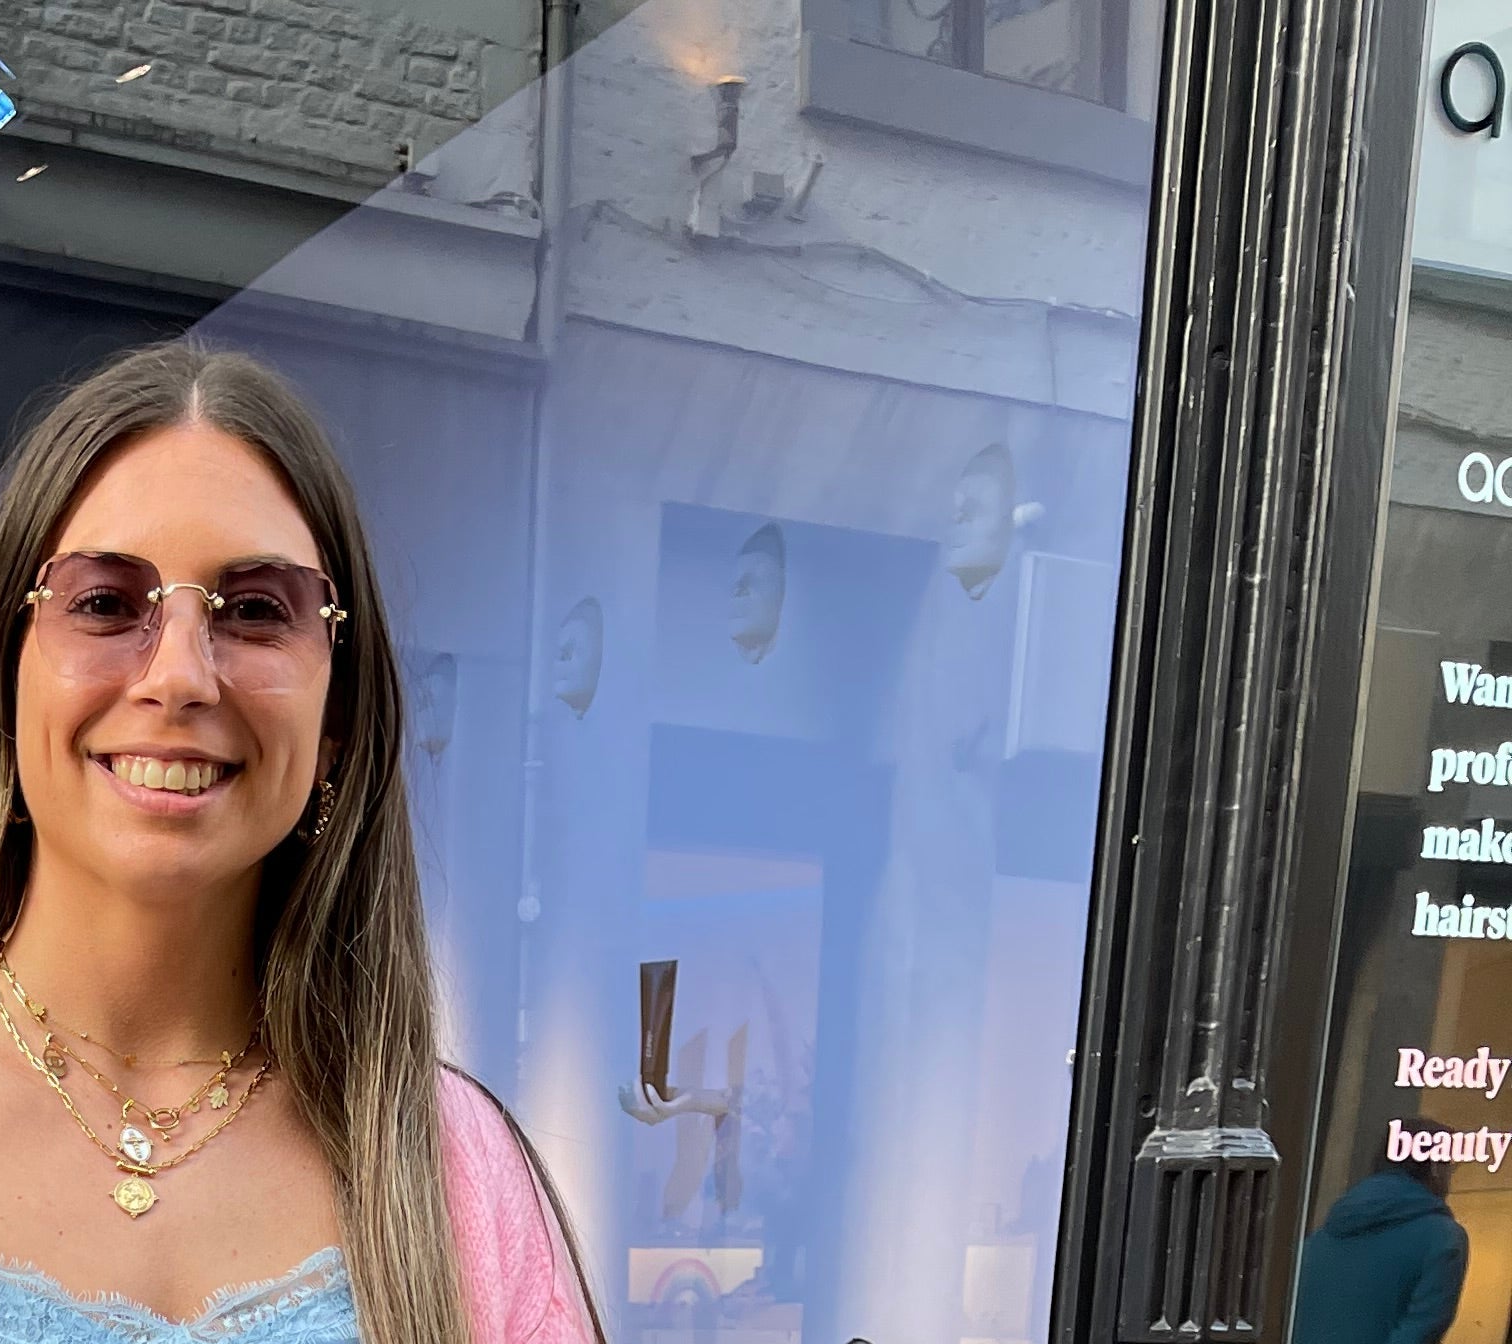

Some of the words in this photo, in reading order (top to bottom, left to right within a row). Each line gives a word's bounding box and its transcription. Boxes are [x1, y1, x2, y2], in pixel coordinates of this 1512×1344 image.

[1427, 741, 1512, 793] prof
[1394, 1046, 1512, 1099] Ready
[1386, 1119, 1512, 1173] beauty
